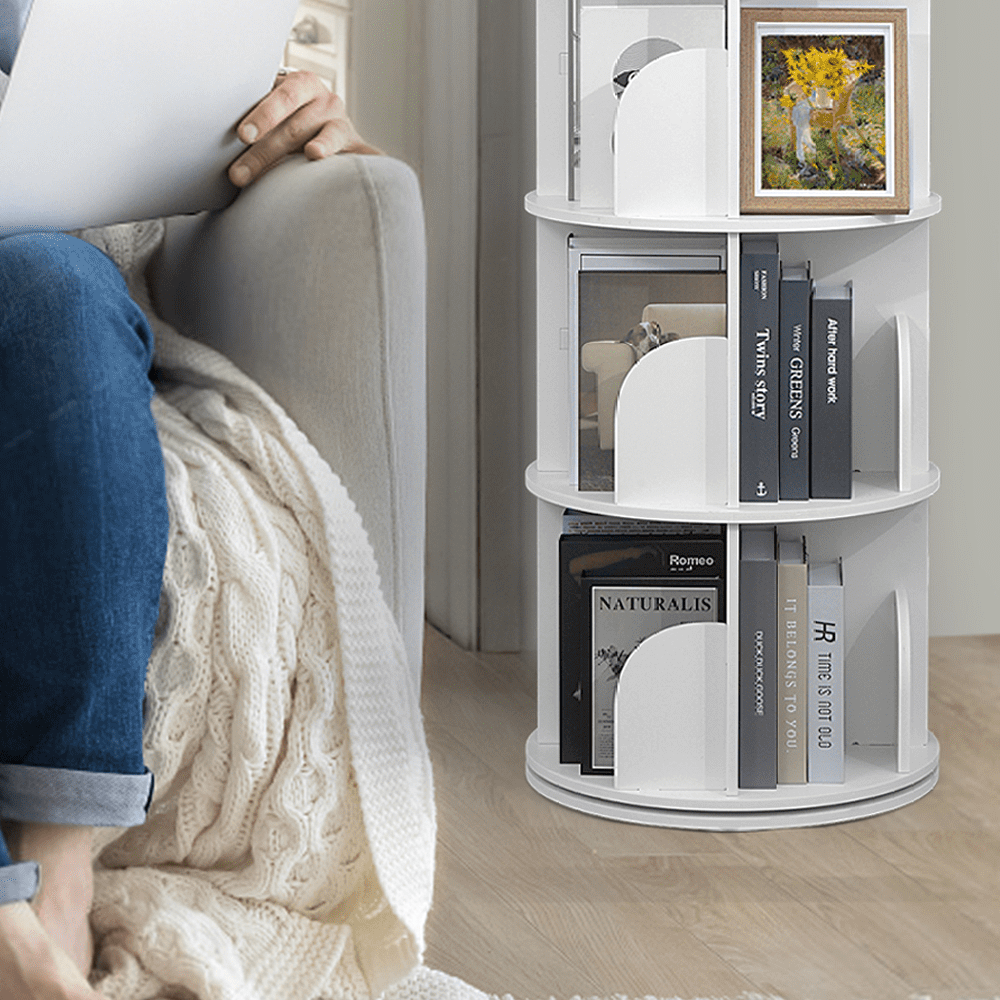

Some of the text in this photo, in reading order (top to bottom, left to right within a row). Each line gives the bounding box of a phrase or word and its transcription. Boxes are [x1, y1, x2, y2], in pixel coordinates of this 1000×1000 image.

[751, 328, 771, 421] Twins story
[826, 317, 839, 404] After hard work
[789, 357, 804, 420] GREENS
[669, 554, 714, 566] Romeo
[599, 596, 711, 611] NATURALIS
[784, 598, 797, 753] IT BELONGS TO YOU.
[818, 652, 832, 681] TIME
[818, 685, 831, 696] IS
